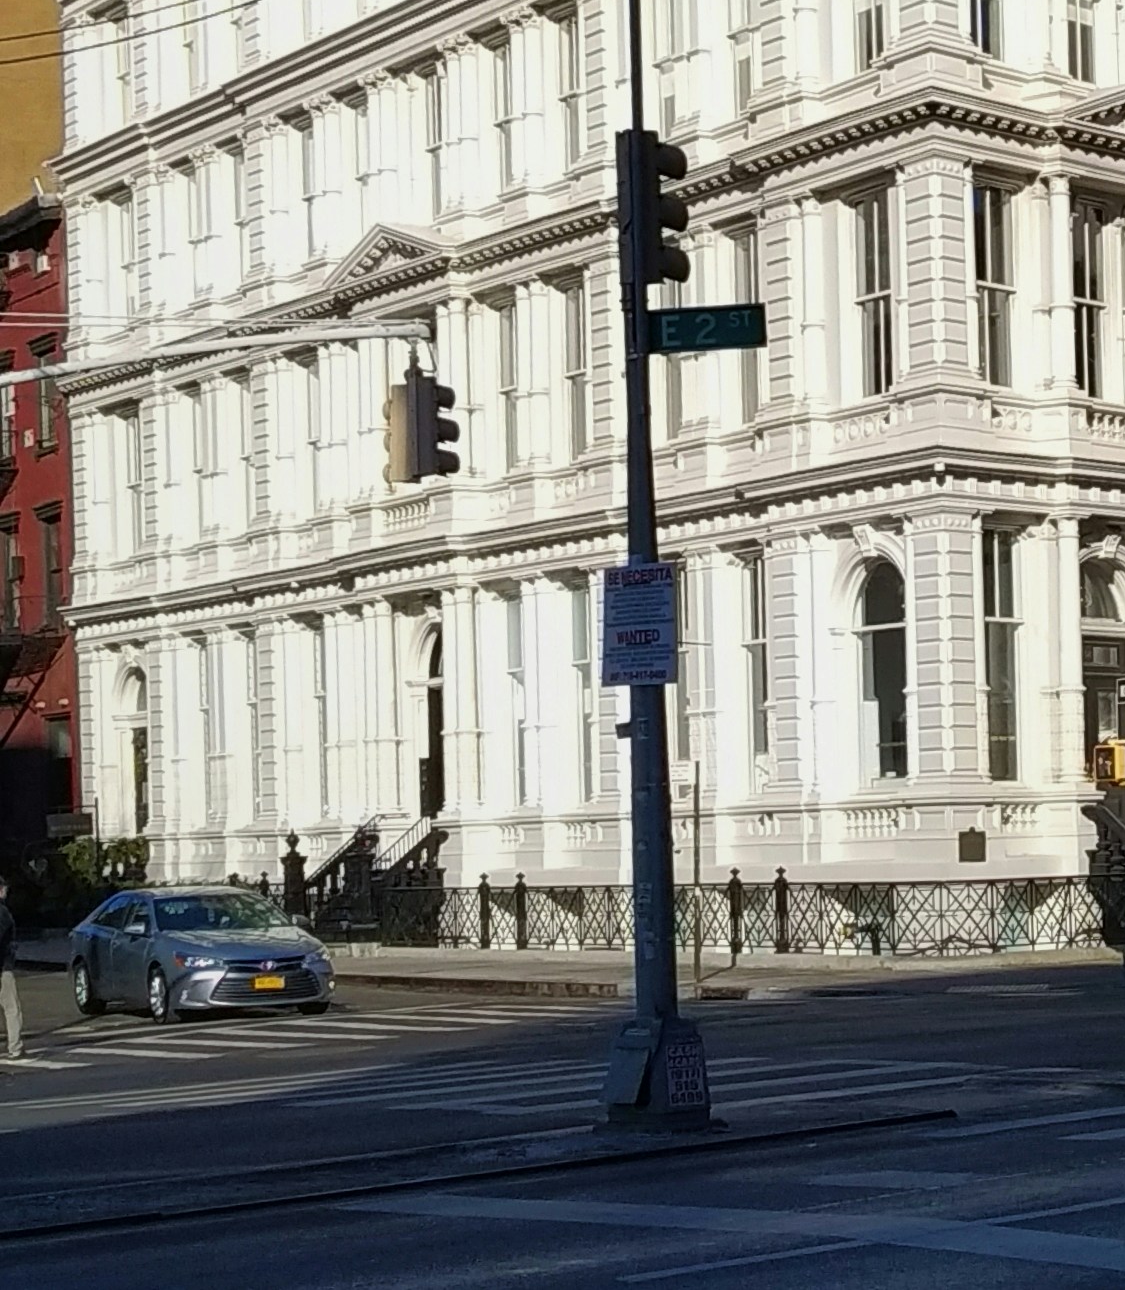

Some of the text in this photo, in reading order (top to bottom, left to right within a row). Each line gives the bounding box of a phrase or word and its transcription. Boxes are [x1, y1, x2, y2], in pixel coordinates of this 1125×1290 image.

[661, 310, 752, 347] E 2 ST
[608, 567, 673, 586] SE NECESITA
[616, 628, 661, 645] WANTED
